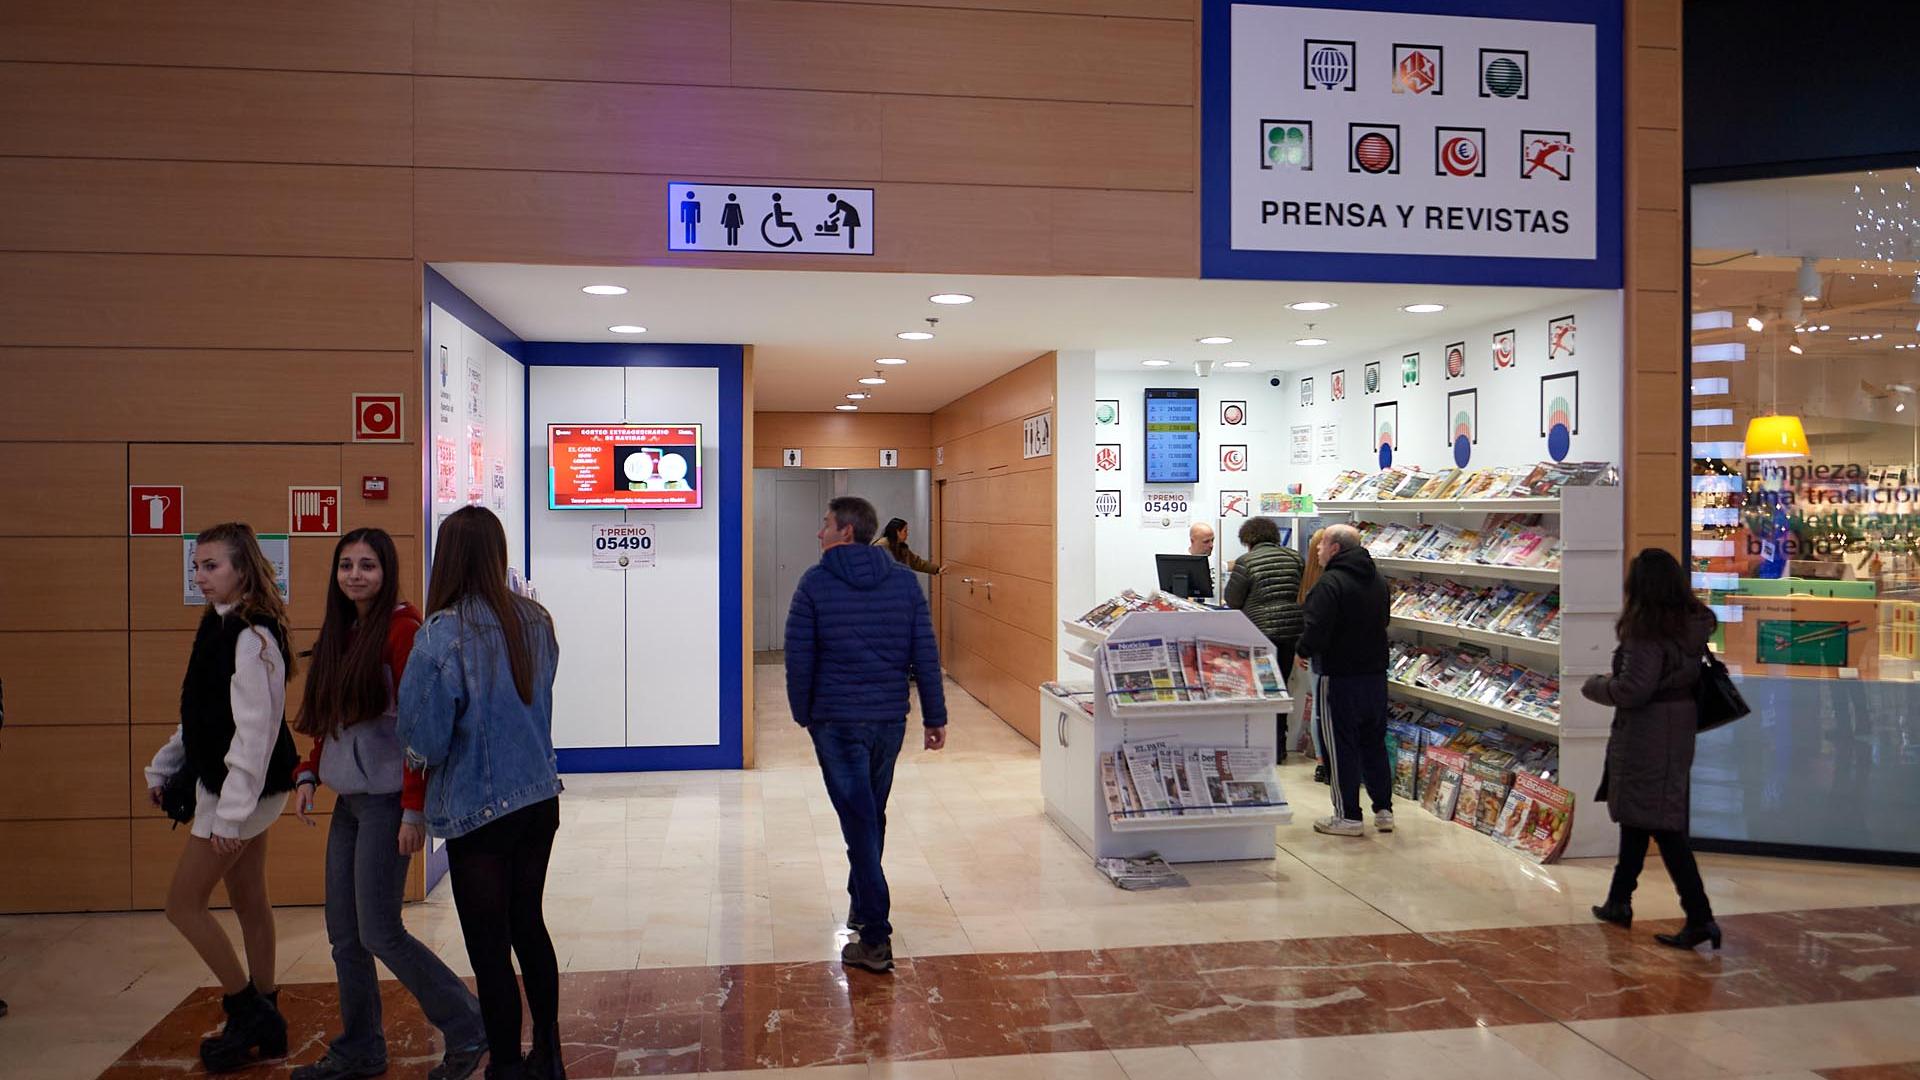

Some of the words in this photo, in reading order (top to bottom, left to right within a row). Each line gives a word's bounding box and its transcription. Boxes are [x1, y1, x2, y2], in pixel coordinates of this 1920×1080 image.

[1261, 201, 1387, 228] PRENSA
[1396, 205, 1414, 228] Y
[1425, 207, 1570, 234] REVISTAS
[1745, 459, 1861, 486] Empieza
[1144, 501, 1187, 512] 05490
[607, 528, 647, 536] PREMIO
[596, 536, 651, 550] 05490
[1747, 534, 1830, 555] bena
